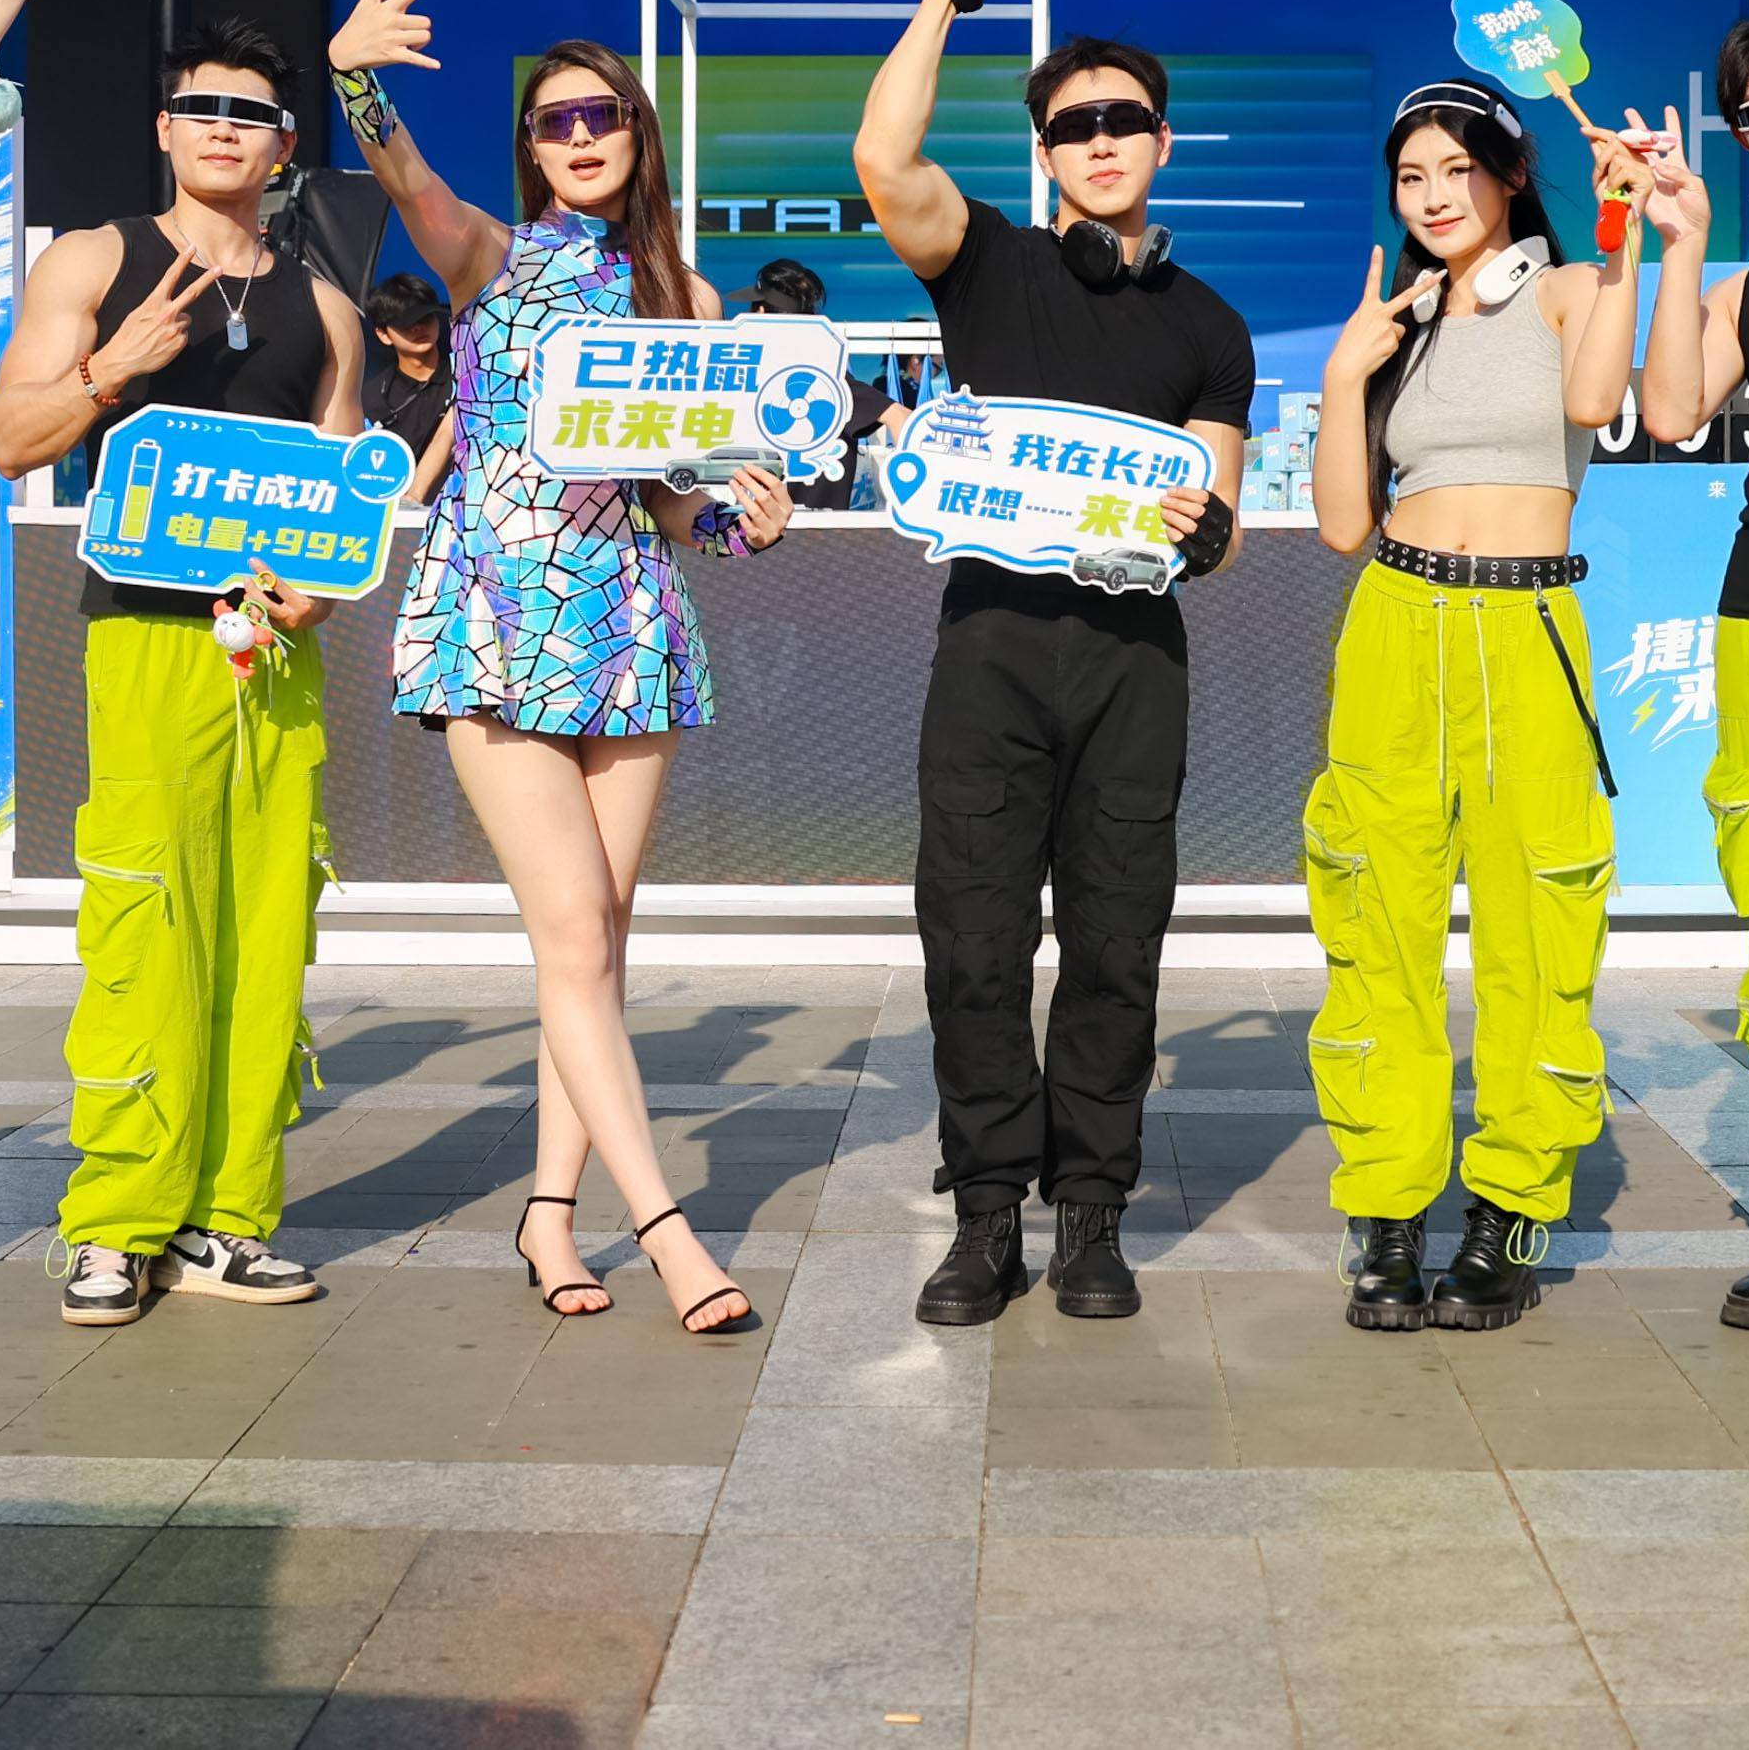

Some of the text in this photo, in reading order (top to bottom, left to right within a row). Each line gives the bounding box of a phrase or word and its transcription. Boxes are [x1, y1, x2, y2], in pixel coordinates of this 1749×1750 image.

[574, 339, 764, 393] 已热鼠
[552, 399, 735, 449] 求来电
[1008, 433, 1191, 490] 我在长沙
[171, 462, 339, 514] 打卡成功
[165, 513, 371, 565] 电量+99%
